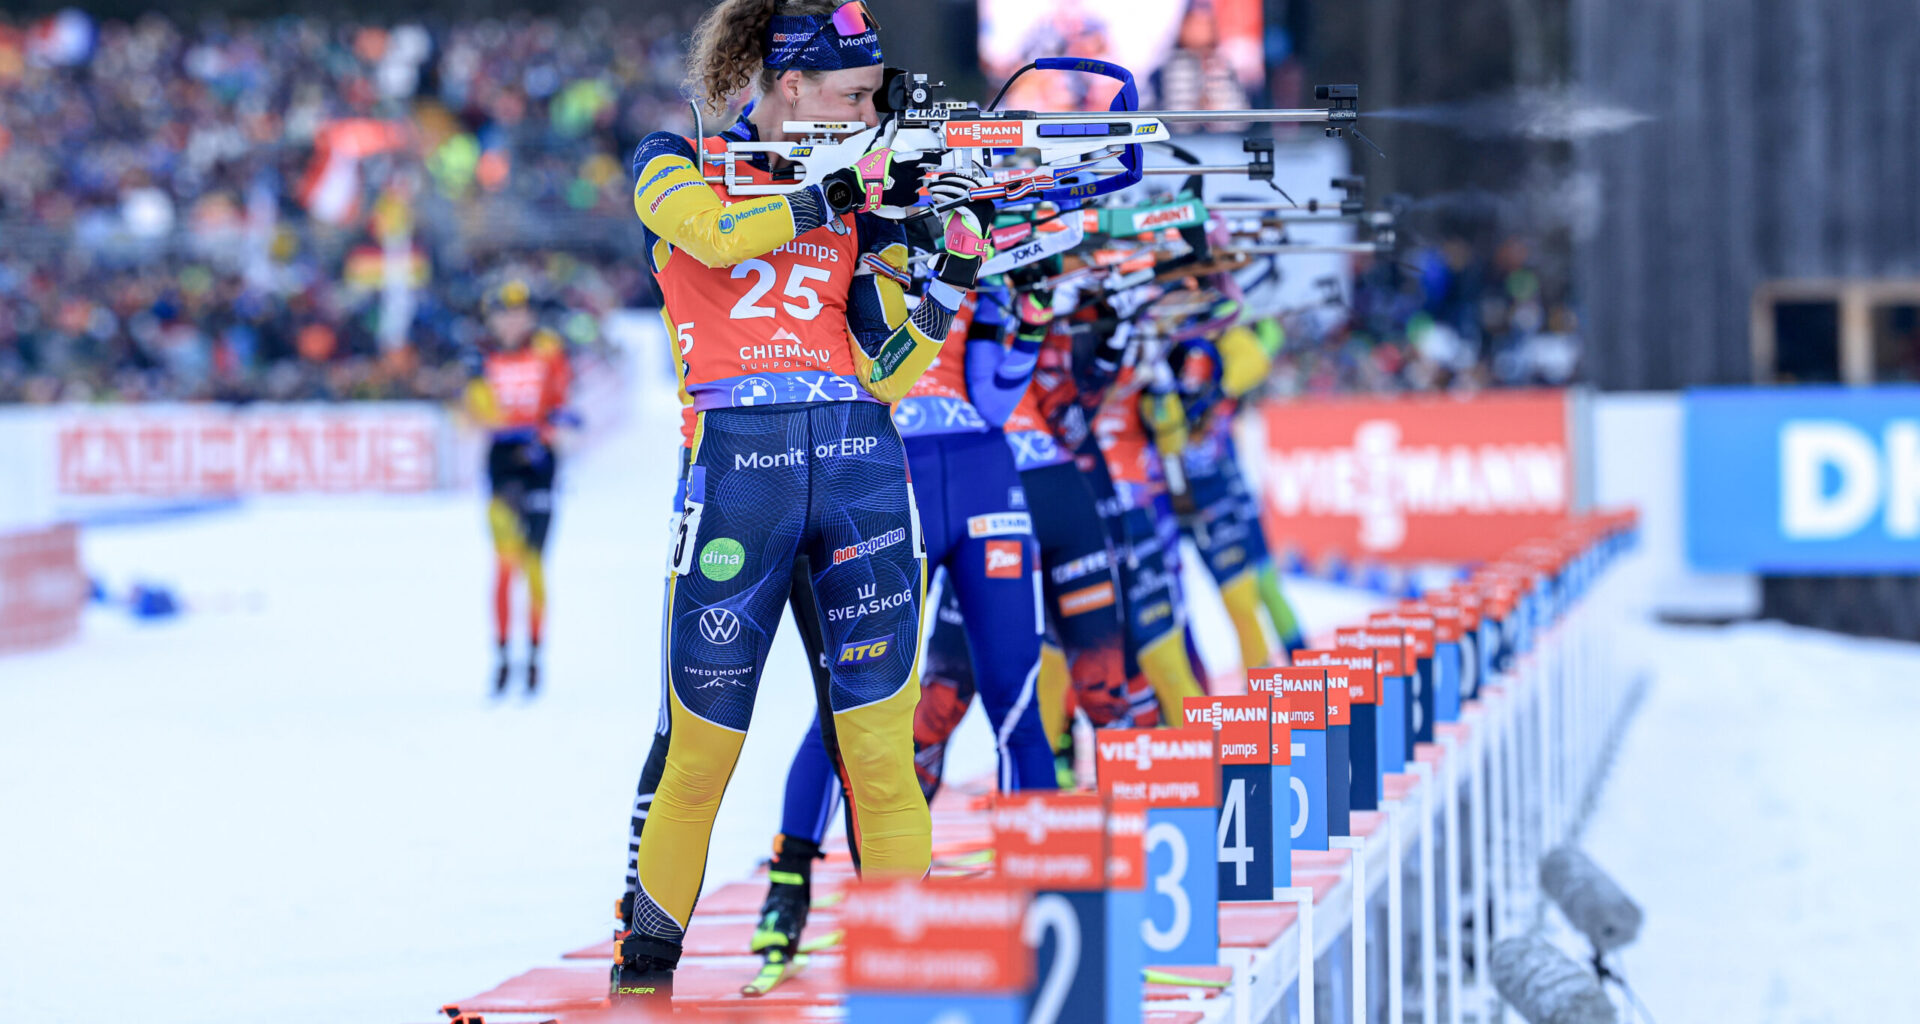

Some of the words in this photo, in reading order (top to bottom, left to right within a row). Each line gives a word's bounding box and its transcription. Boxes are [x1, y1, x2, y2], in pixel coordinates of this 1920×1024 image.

[918, 109, 949, 118] LKAB
[948, 123, 1021, 140] VIESSMANN
[1136, 124, 1157, 134] ATG
[791, 147, 812, 156] ATG
[1069, 182, 1097, 196] ATG
[735, 205, 768, 223] Monitor
[767, 201, 783, 212] ERP
[773, 240, 839, 263] pumps
[1011, 242, 1044, 263] JOKA
[729, 258, 831, 321] 25
[841, 436, 878, 456] ERP
[833, 527, 906, 565] Autoexperten
[703, 552, 740, 565] dina
[828, 589, 912, 621] SVEASKOG
[840, 641, 888, 661] ATG
[684, 666, 753, 676] SWEDEMOUNT
[1250, 673, 1323, 698] VIESSMANN
[1185, 702, 1268, 731] VIESSMANN
[1290, 711, 1315, 724] umps
[1100, 734, 1213, 771] VIESSMANN
[1221, 743, 1258, 759] pumps
[1112, 781, 1147, 799] Heat
[1149, 782, 1200, 803] pumps
[1217, 778, 1254, 887] 4
[1141, 820, 1192, 953] 3
[1021, 893, 1082, 1024] 2
[618, 986, 656, 995] SCHER
